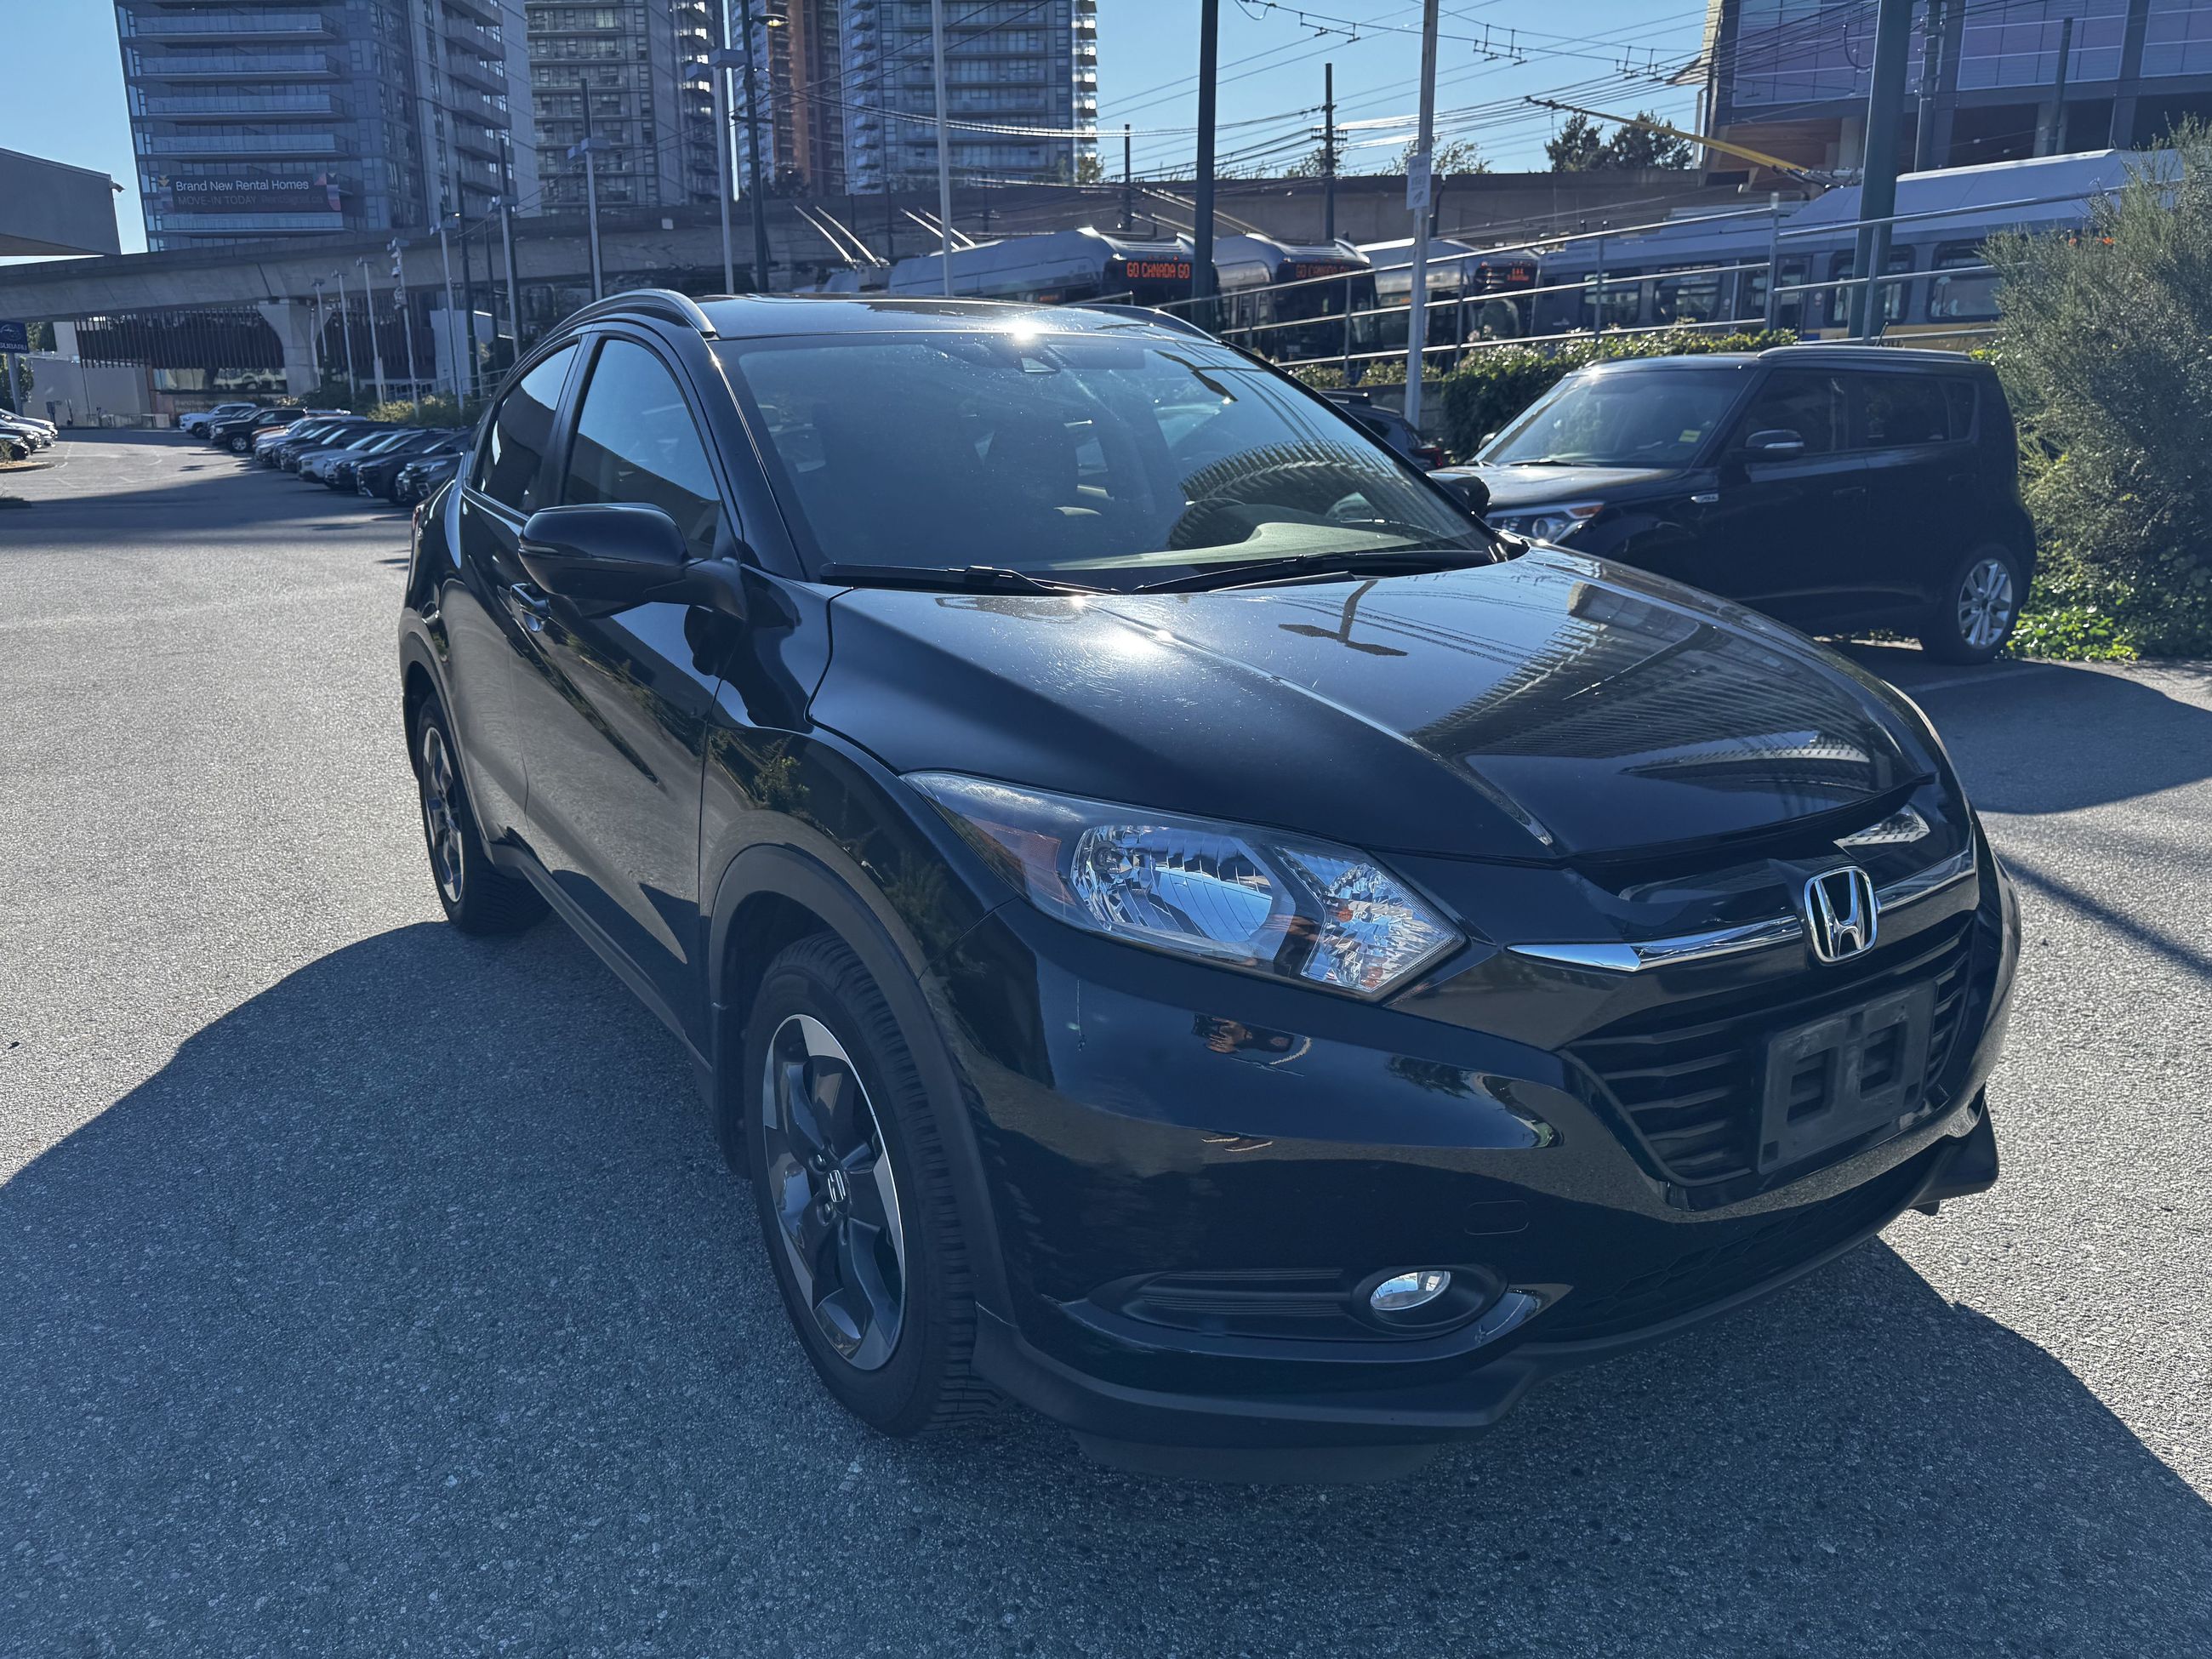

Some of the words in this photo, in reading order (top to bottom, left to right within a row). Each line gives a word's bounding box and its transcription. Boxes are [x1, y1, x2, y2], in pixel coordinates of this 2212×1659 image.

[176, 180, 207, 191] Brand
[210, 180, 233, 191] New
[236, 180, 269, 191] Rental
[272, 180, 309, 190] Homes
[178, 196, 221, 205] MOVE-IN
[225, 196, 257, 205] TODAY
[1126, 262, 1140, 277] GO
[1142, 262, 1176, 278] CANADA
[1177, 263, 1190, 279] GO
[1296, 264, 1307, 278] GO
